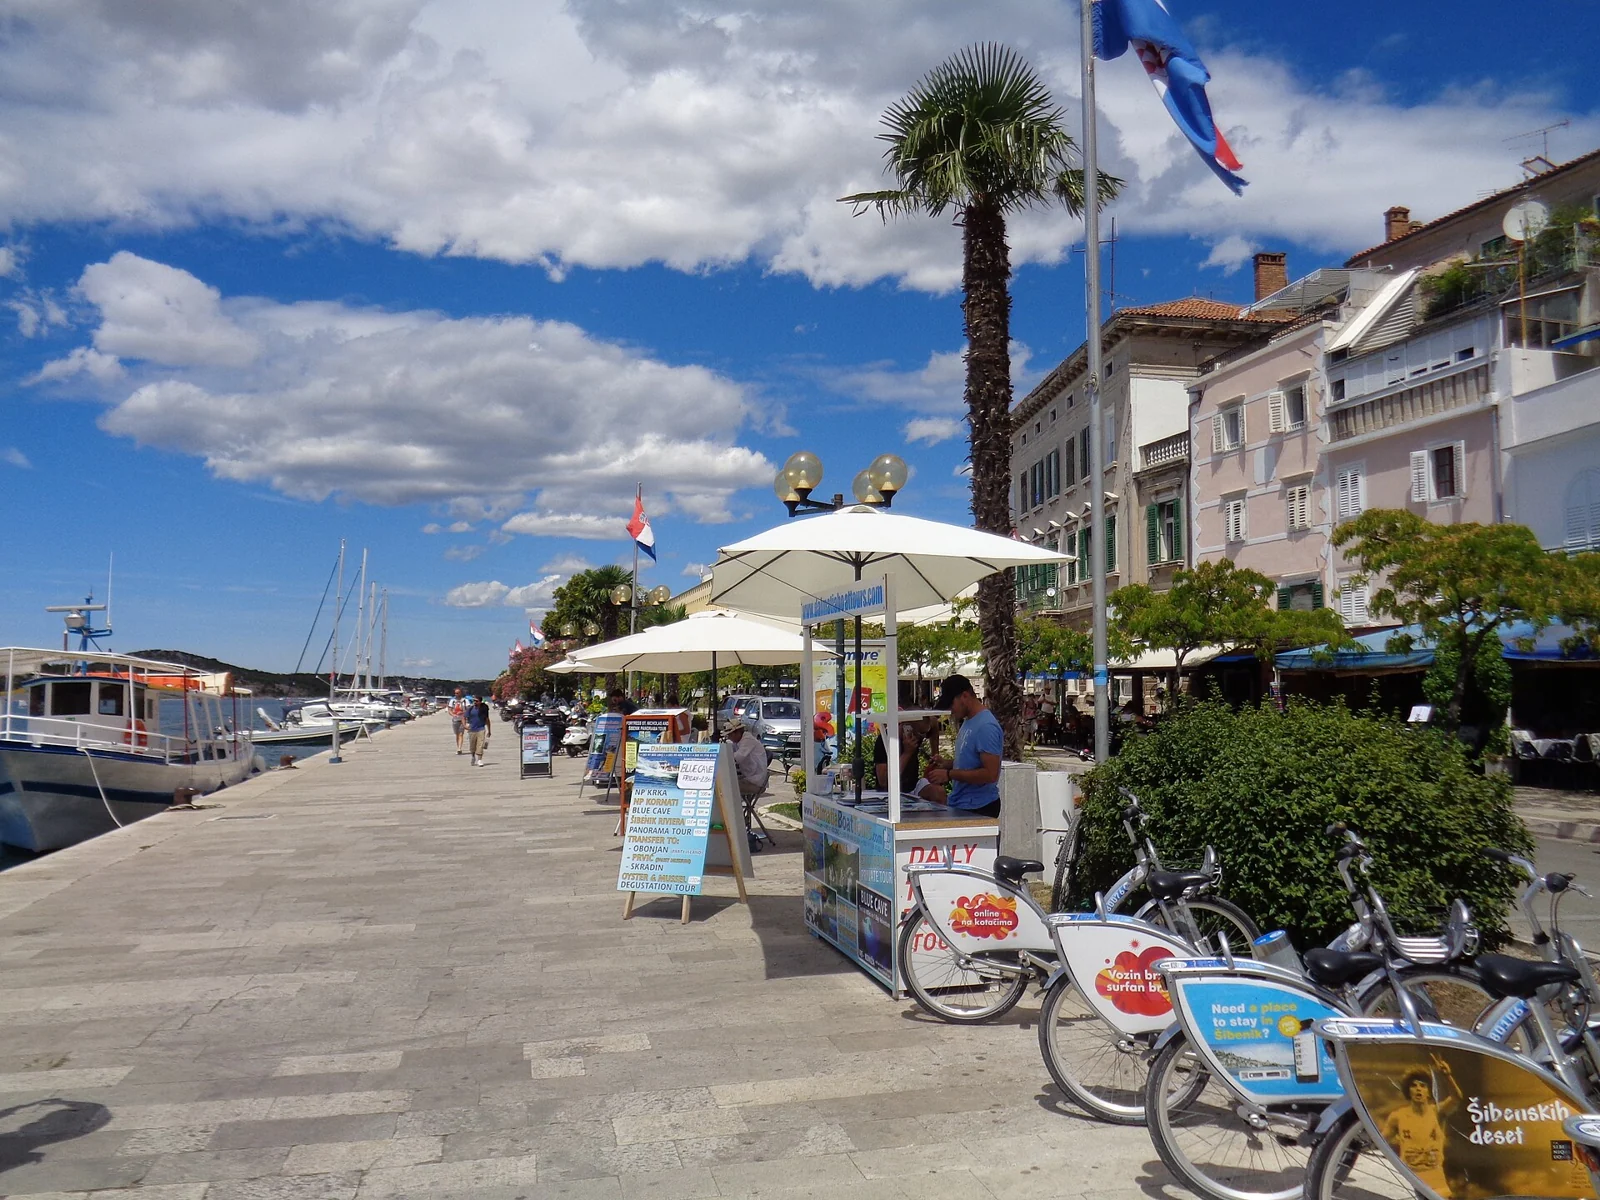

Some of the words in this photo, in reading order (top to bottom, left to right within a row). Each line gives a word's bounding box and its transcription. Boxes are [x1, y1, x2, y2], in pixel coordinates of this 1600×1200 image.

[647, 789, 668, 797] KRKA
[633, 798, 645, 806] NP
[646, 798, 679, 807] KORNATI
[652, 807, 671, 815] CAVE
[658, 817, 686, 826] RIVIERA
[629, 826, 670, 835] PANORAMA
[672, 827, 692, 836] TOUR
[627, 836, 665, 844] TRANSFER
[667, 837, 680, 845] TO:
[633, 845, 669, 854] OBONJAN
[630, 863, 664, 871] SKRADIN
[622, 872, 649, 881] OYSTER
[658, 875, 687, 883] MUSSEL
[620, 881, 672, 891] DEGUSTATION
[675, 884, 696, 892] TOUR
[860, 889, 874, 909] BLUE
[874, 896, 888, 917] CAVE
[974, 909, 1000, 918] online
[974, 917, 1013, 926] kotačima
[1107, 969, 1141, 980] Vozin
[1106, 981, 1145, 992] surfan
[1211, 1003, 1245, 1014] Need
[1249, 1005, 1257, 1013] a
[1261, 1002, 1298, 1015] place
[1212, 1017, 1226, 1027] to
[1229, 1017, 1258, 1029] stay
[1261, 1015, 1274, 1026] in
[1466, 1097, 1569, 1123] Šibenskih
[1469, 1125, 1524, 1145] deset
